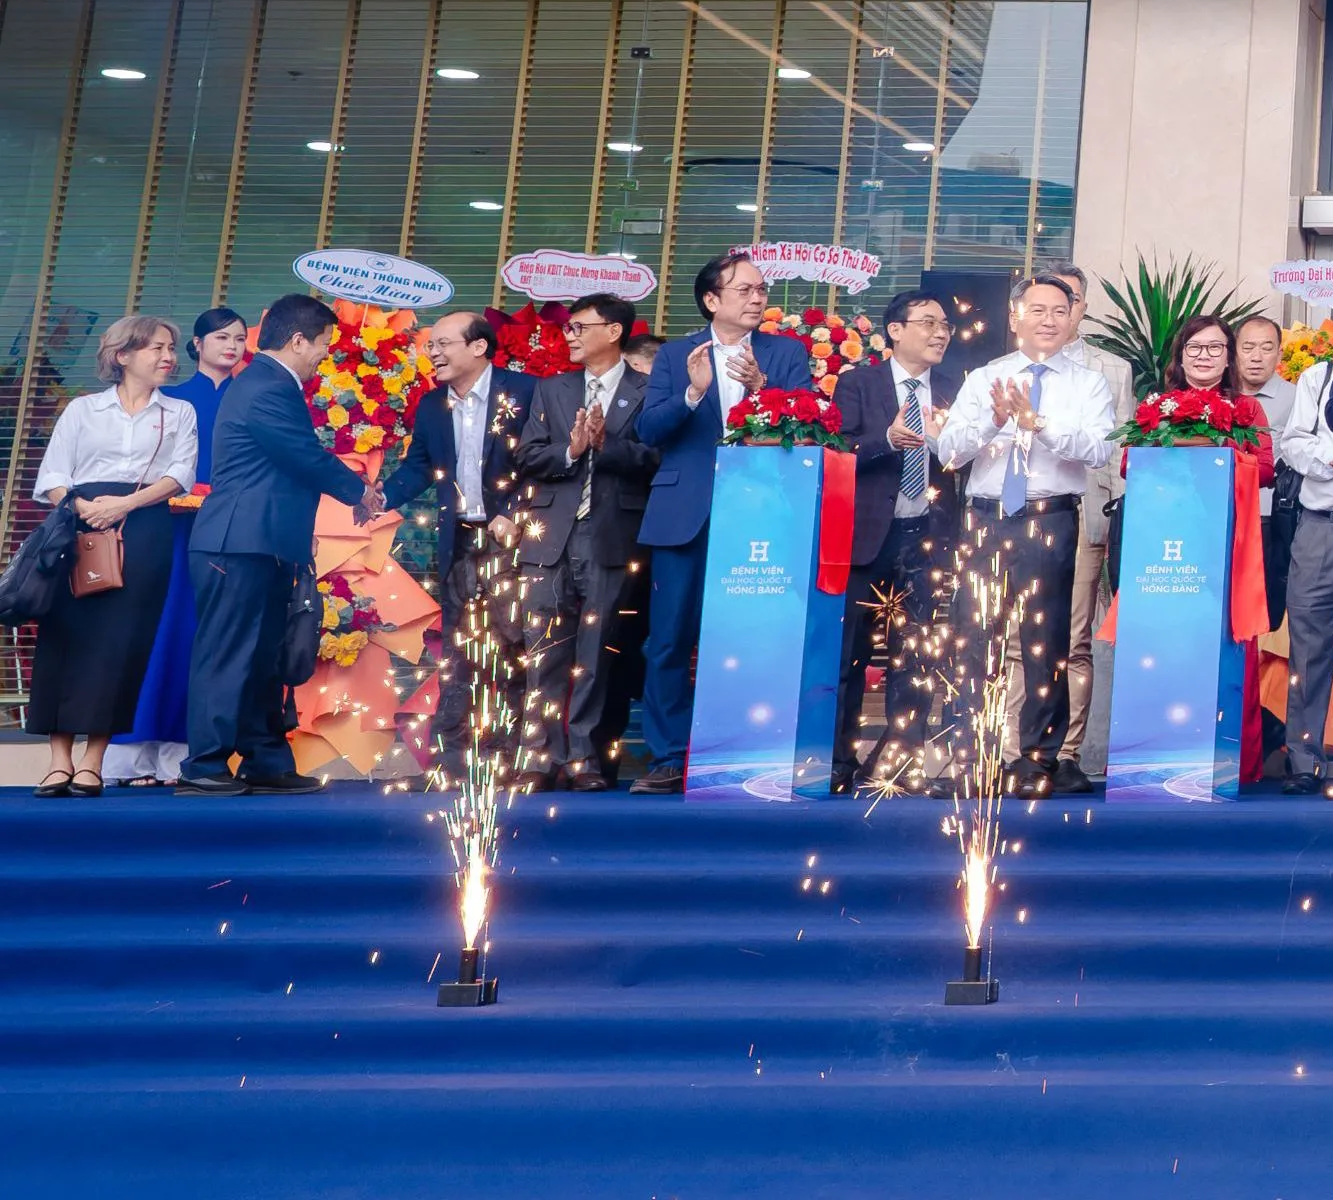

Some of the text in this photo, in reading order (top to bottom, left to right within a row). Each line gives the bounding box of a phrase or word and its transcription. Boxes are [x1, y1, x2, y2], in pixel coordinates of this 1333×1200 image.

[752, 241, 777, 262] Hiểm
[780, 244, 792, 261] Xã
[795, 245, 811, 262] Hội
[842, 249, 859, 270] Thủ
[307, 259, 444, 293] BỆNH VIỆN THỐNG NHẤT
[318, 272, 365, 291] Chúc
[1273, 266, 1305, 285] Trường
[1308, 266, 1323, 284] Đại
[749, 541, 770, 562] H
[1162, 540, 1184, 561] H
